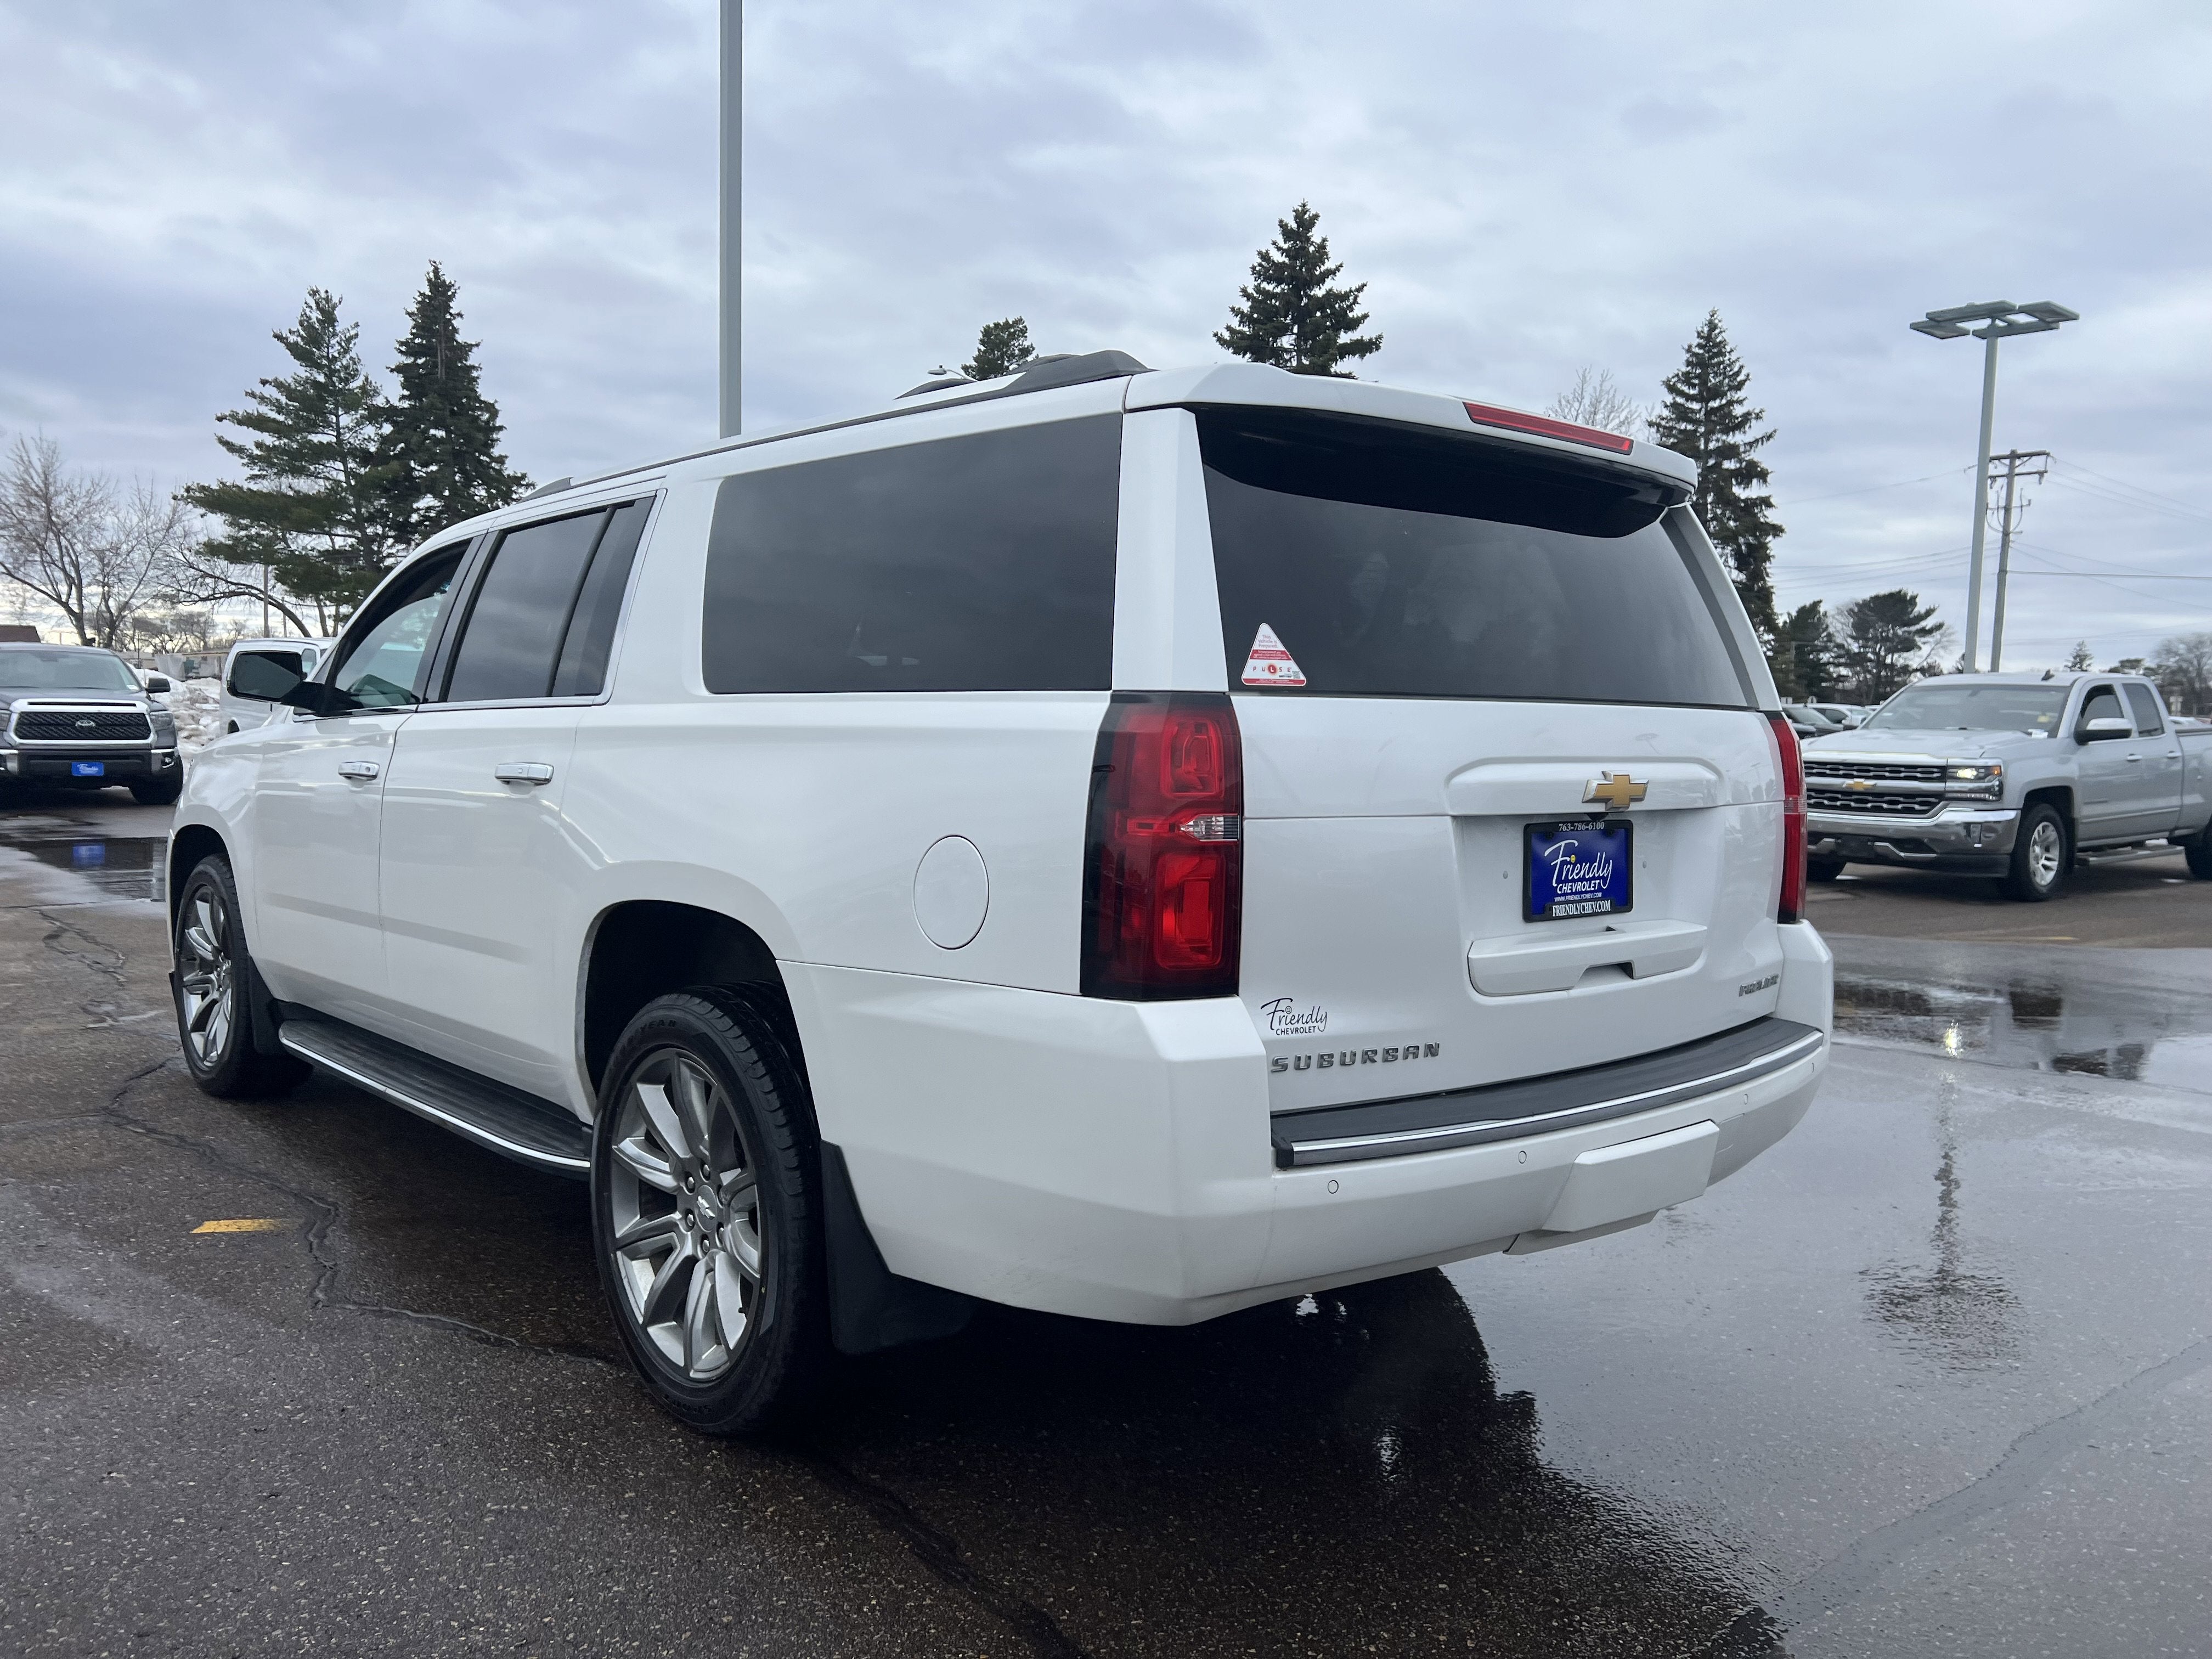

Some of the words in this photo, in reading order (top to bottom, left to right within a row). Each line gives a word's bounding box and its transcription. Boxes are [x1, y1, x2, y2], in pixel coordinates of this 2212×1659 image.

[1559, 822, 1605, 832] 763-786-6100
[1544, 839, 1612, 889] Friendly
[1557, 879, 1600, 894] CHEVROLET
[1554, 892, 1602, 902] WWW.FRIENDLYCHEV.COM
[1552, 900, 1611, 917] FRIENDLYCHEV.COM
[1260, 997, 1328, 1032] Friendly
[1276, 1025, 1317, 1036] CHEVROLET
[1271, 1041, 1440, 1073] SUBURBAN
